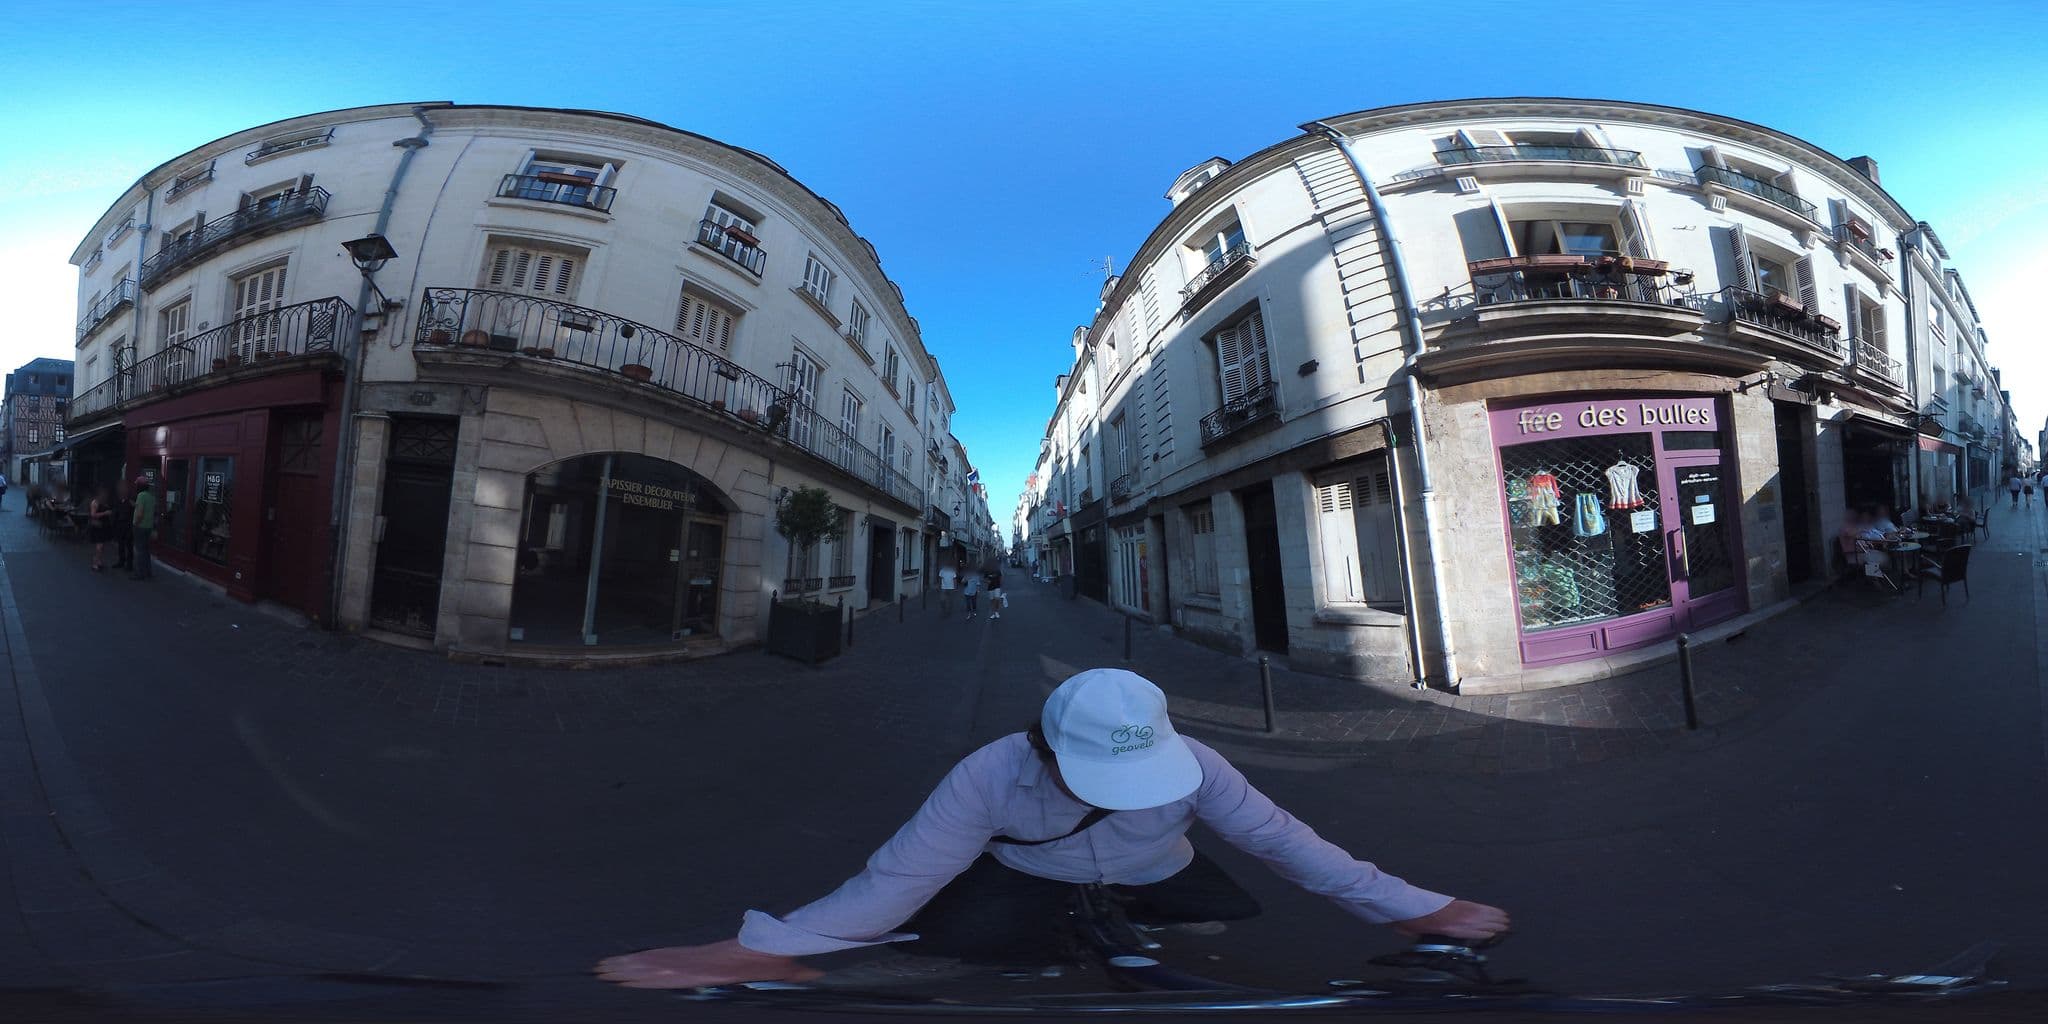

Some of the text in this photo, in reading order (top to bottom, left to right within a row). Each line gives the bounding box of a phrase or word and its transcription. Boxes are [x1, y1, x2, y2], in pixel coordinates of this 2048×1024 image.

[1579, 404, 1628, 428] des
[1640, 403, 1710, 426] bulles
[600, 476, 643, 493] TAPISSIER
[1112, 740, 1154, 755] geovelo
